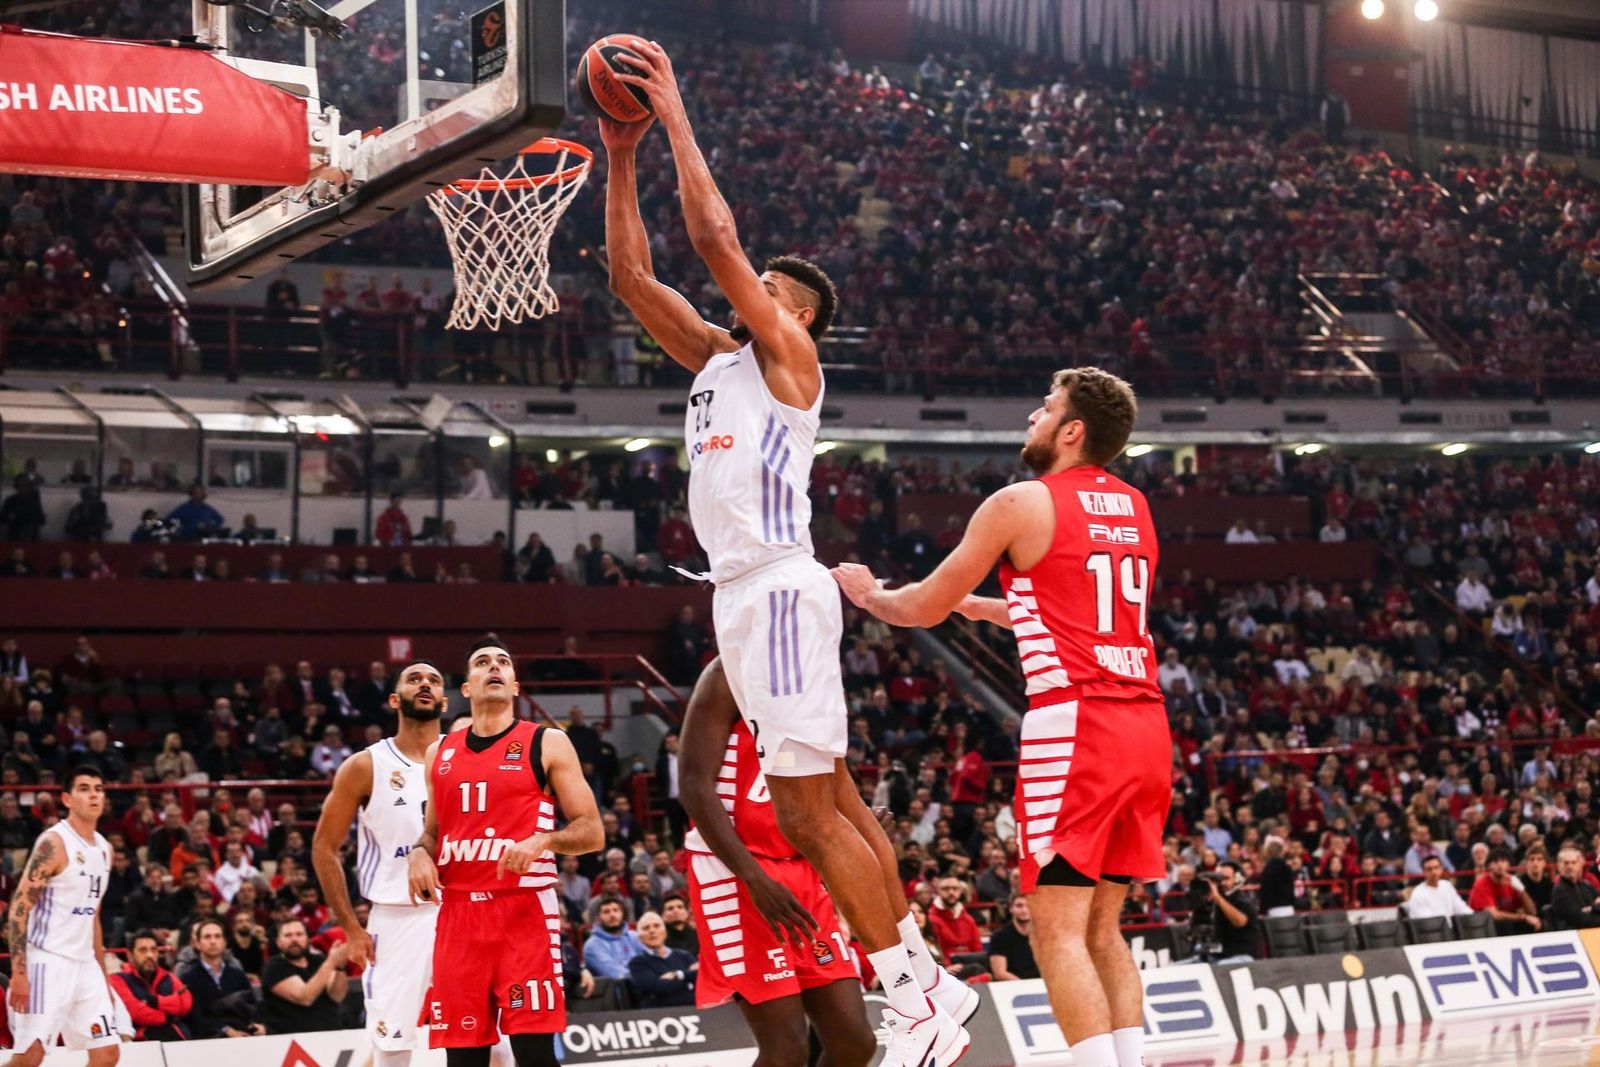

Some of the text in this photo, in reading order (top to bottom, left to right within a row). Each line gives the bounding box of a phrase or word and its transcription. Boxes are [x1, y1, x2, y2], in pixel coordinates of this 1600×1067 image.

[49, 84, 204, 115] AIRLINES
[1076, 490, 1135, 517] VEZENKOV
[1088, 523, 1140, 545] FMS
[1086, 552, 1149, 638] 14
[459, 782, 488, 813] 11
[437, 827, 516, 866] bwin
[88, 874, 101, 898] 14
[1422, 943, 1588, 1005] FMS
[526, 979, 555, 1011] 11
[1230, 954, 1423, 1041] bwin
[1012, 979, 1214, 1048] FS
[563, 1015, 706, 1053] ΟΜΗΡΟΣ
